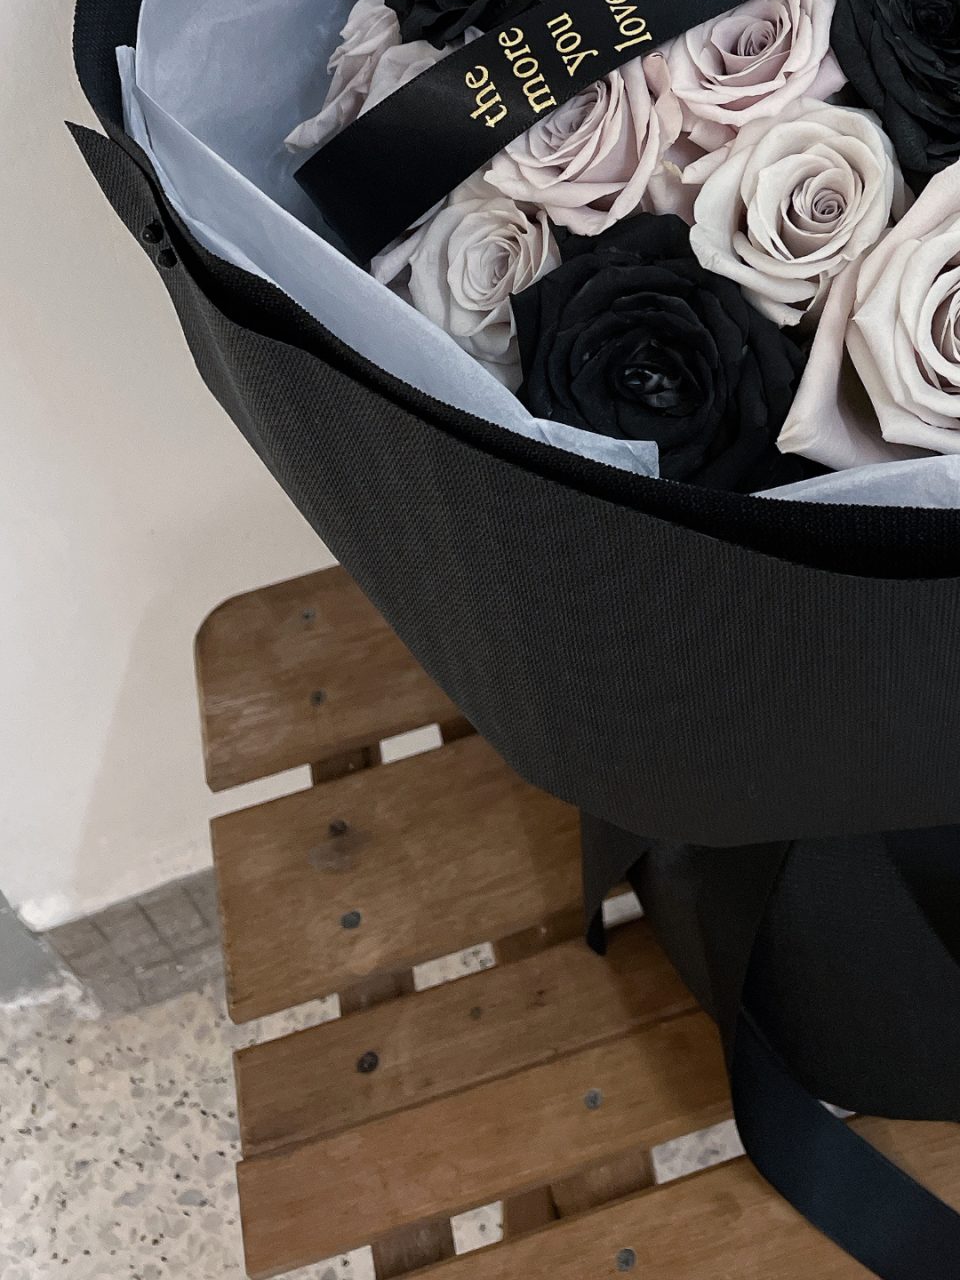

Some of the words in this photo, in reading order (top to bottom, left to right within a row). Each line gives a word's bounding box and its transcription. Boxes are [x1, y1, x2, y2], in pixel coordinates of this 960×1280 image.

[498, 27, 557, 113] more
[546, 12, 599, 76] you
[465, 65, 508, 127] the
